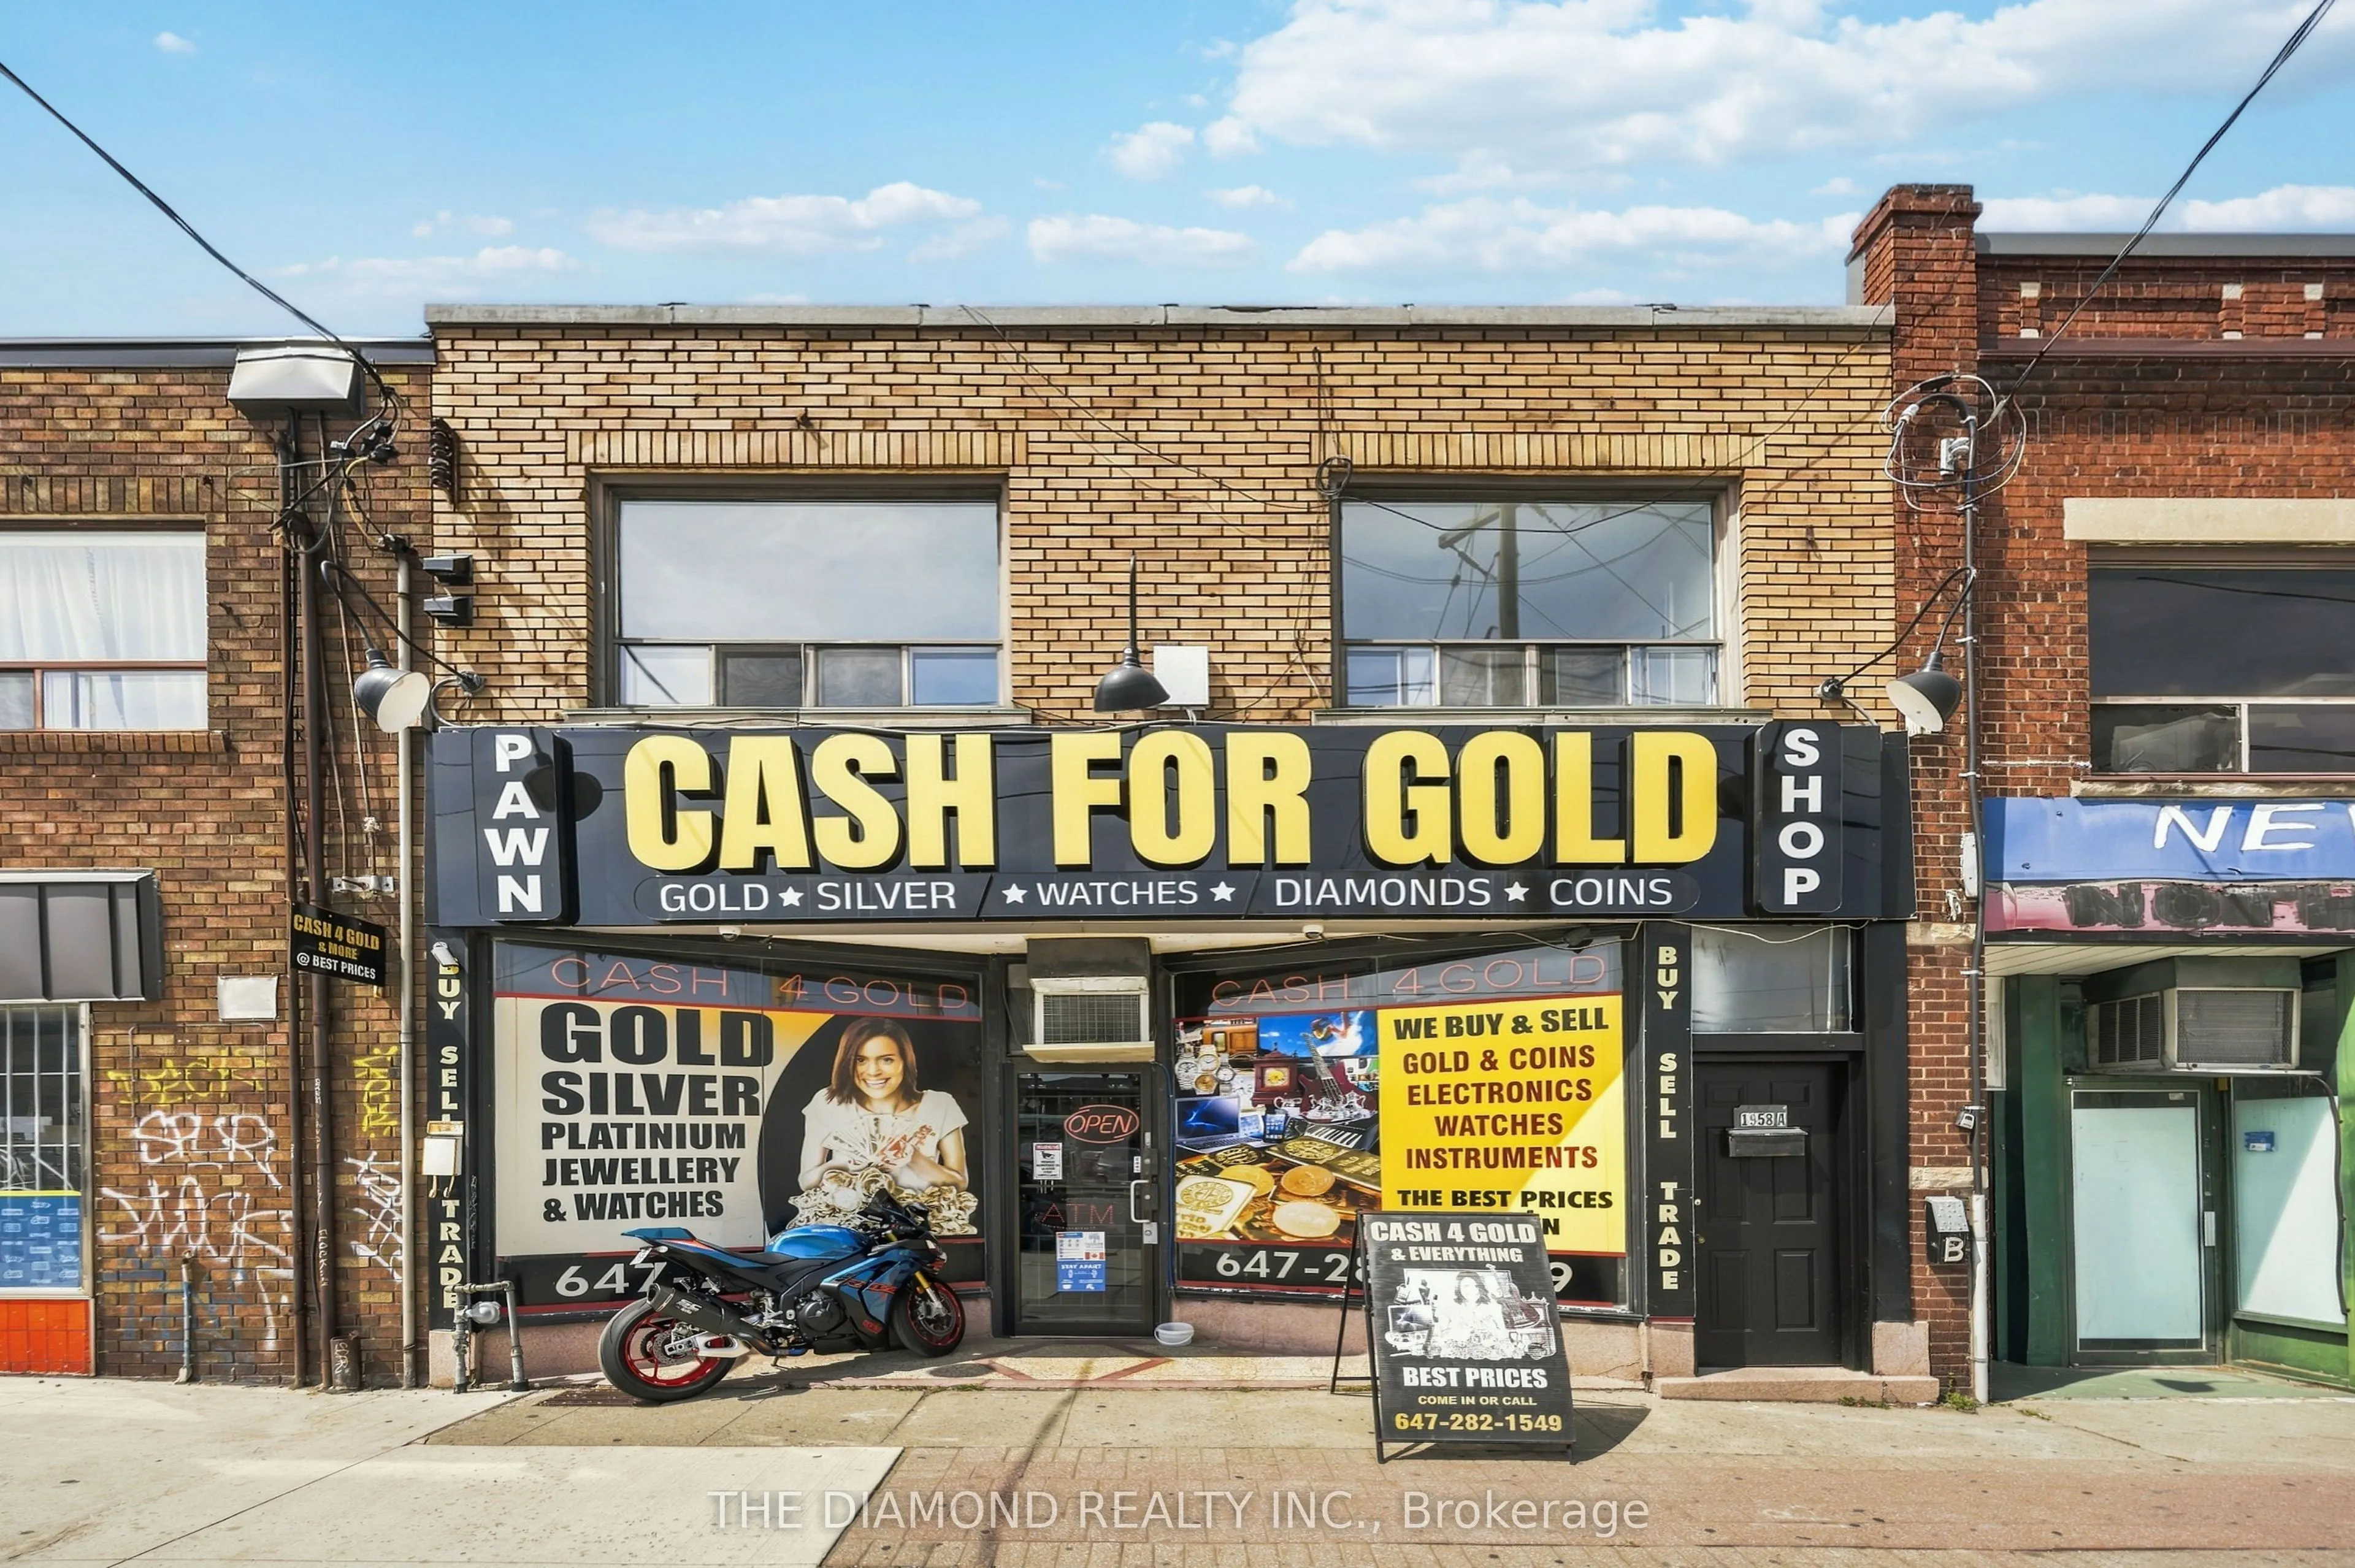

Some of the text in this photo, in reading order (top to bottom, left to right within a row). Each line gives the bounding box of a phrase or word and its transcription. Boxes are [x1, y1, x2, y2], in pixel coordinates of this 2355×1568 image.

[624, 730, 1718, 871] CASH FOR GOLD
[484, 734, 550, 913] PAWN
[1778, 729, 1826, 906] SHOP
[2153, 801, 2355, 853] NE
[659, 877, 1673, 912] GOLD SILVER WATCHES DIAMONDS COINS
[293, 914, 380, 950] CASH 4 GOLD
[297, 952, 377, 980] @ BEST PRICES
[318, 941, 358, 960] & MORE
[551, 957, 968, 1009] CASH 4 GOLD
[1211, 955, 1606, 1008] CASH 4 GOLD
[1656, 946, 1679, 1010] BUY
[540, 1002, 773, 1067] GOLD
[1393, 1007, 1609, 1041] WE BUY & SELL
[1403, 1044, 1596, 1075] GOLD & COINS
[541, 1071, 760, 1116] SILVER
[1407, 1078, 1593, 1106] ELECTRONICS
[1658, 1052, 1678, 1139] SELL
[542, 1122, 746, 1150] PLATINIUM
[1068, 1114, 1133, 1134] OPEN
[1434, 1112, 1564, 1138] WATCHES
[542, 1157, 741, 1186] JEWELLERY
[1406, 1145, 1599, 1171] INSTRUMENTS
[543, 1191, 724, 1222] & WATCHES
[1041, 1203, 1114, 1225] ATM
[1396, 1189, 1614, 1209] THE BEST PRICES
[1370, 1221, 1444, 1243] CASH
[1447, 1222, 1466, 1243] 4
[1468, 1223, 1537, 1244] GOLD
[1657, 1181, 1682, 1290] TRADE
[438, 1199, 464, 1308] TRADE
[1391, 1246, 1524, 1263] & EVERYTHING
[1943, 1236, 1964, 1263] B
[1402, 1367, 1549, 1388] BEST PRICES
[1418, 1396, 1538, 1405] COME IN OR CALL
[1395, 1412, 1563, 1432] 647-282-1549
